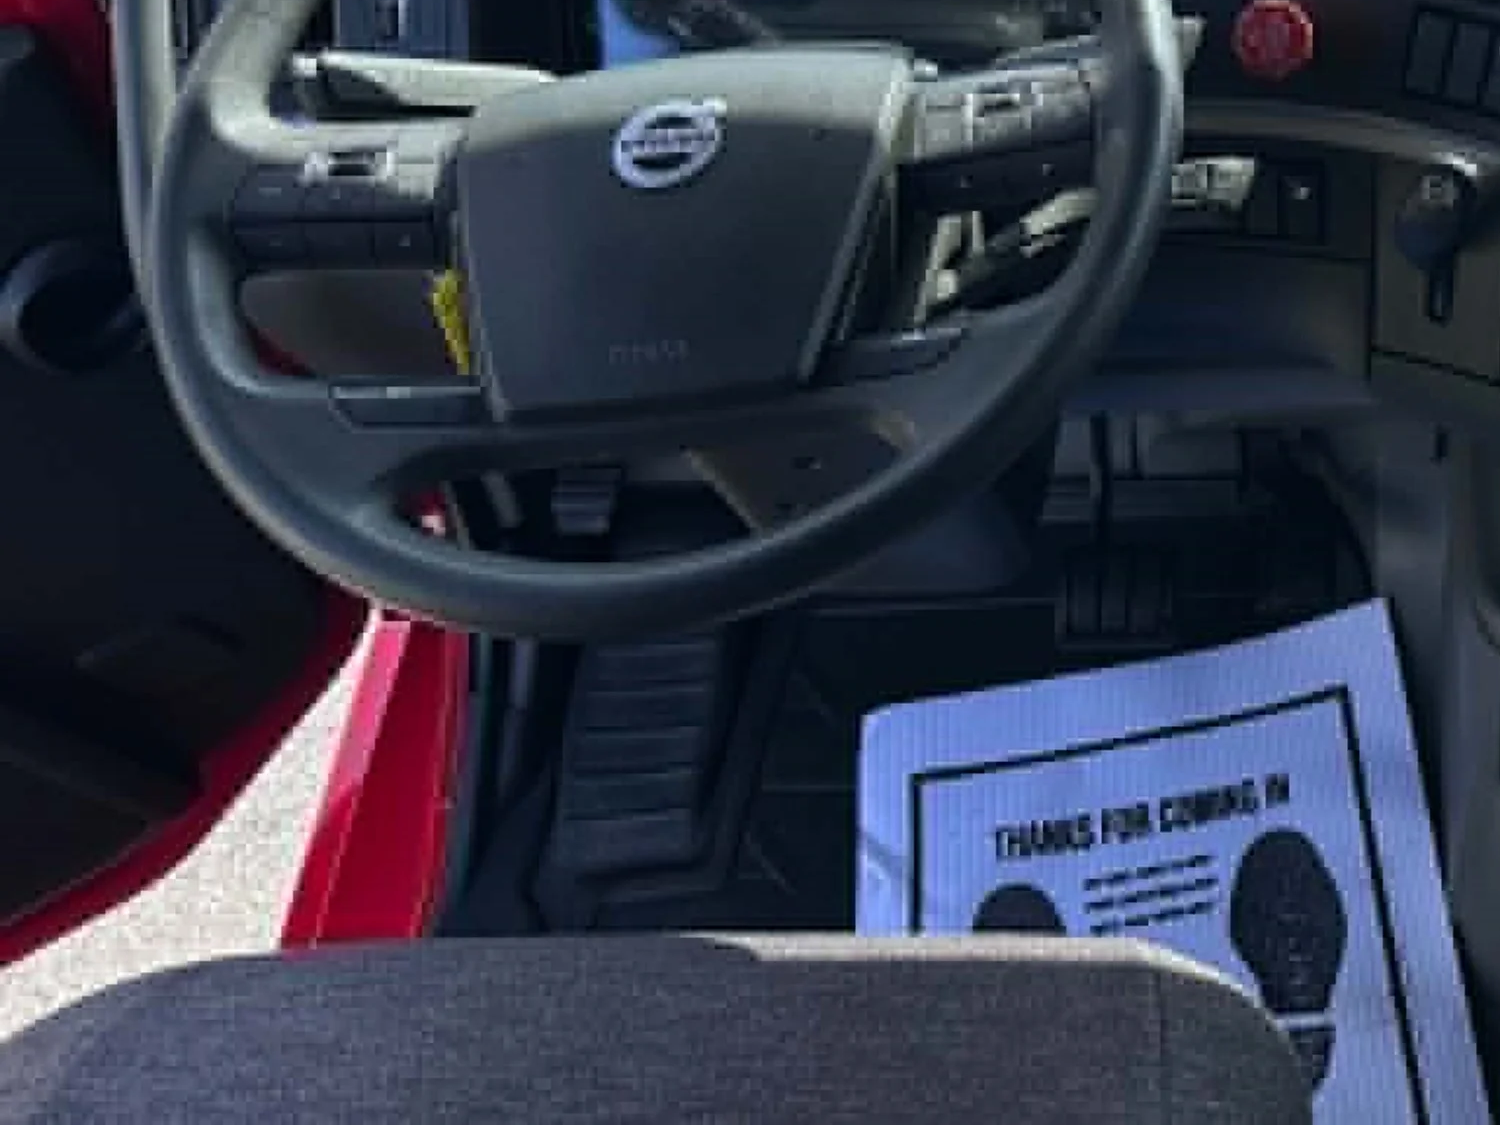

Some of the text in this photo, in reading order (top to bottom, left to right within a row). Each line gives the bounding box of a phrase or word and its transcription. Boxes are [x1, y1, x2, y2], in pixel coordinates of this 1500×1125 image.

[994, 773, 1291, 859] THANKS FOR COMING IN
